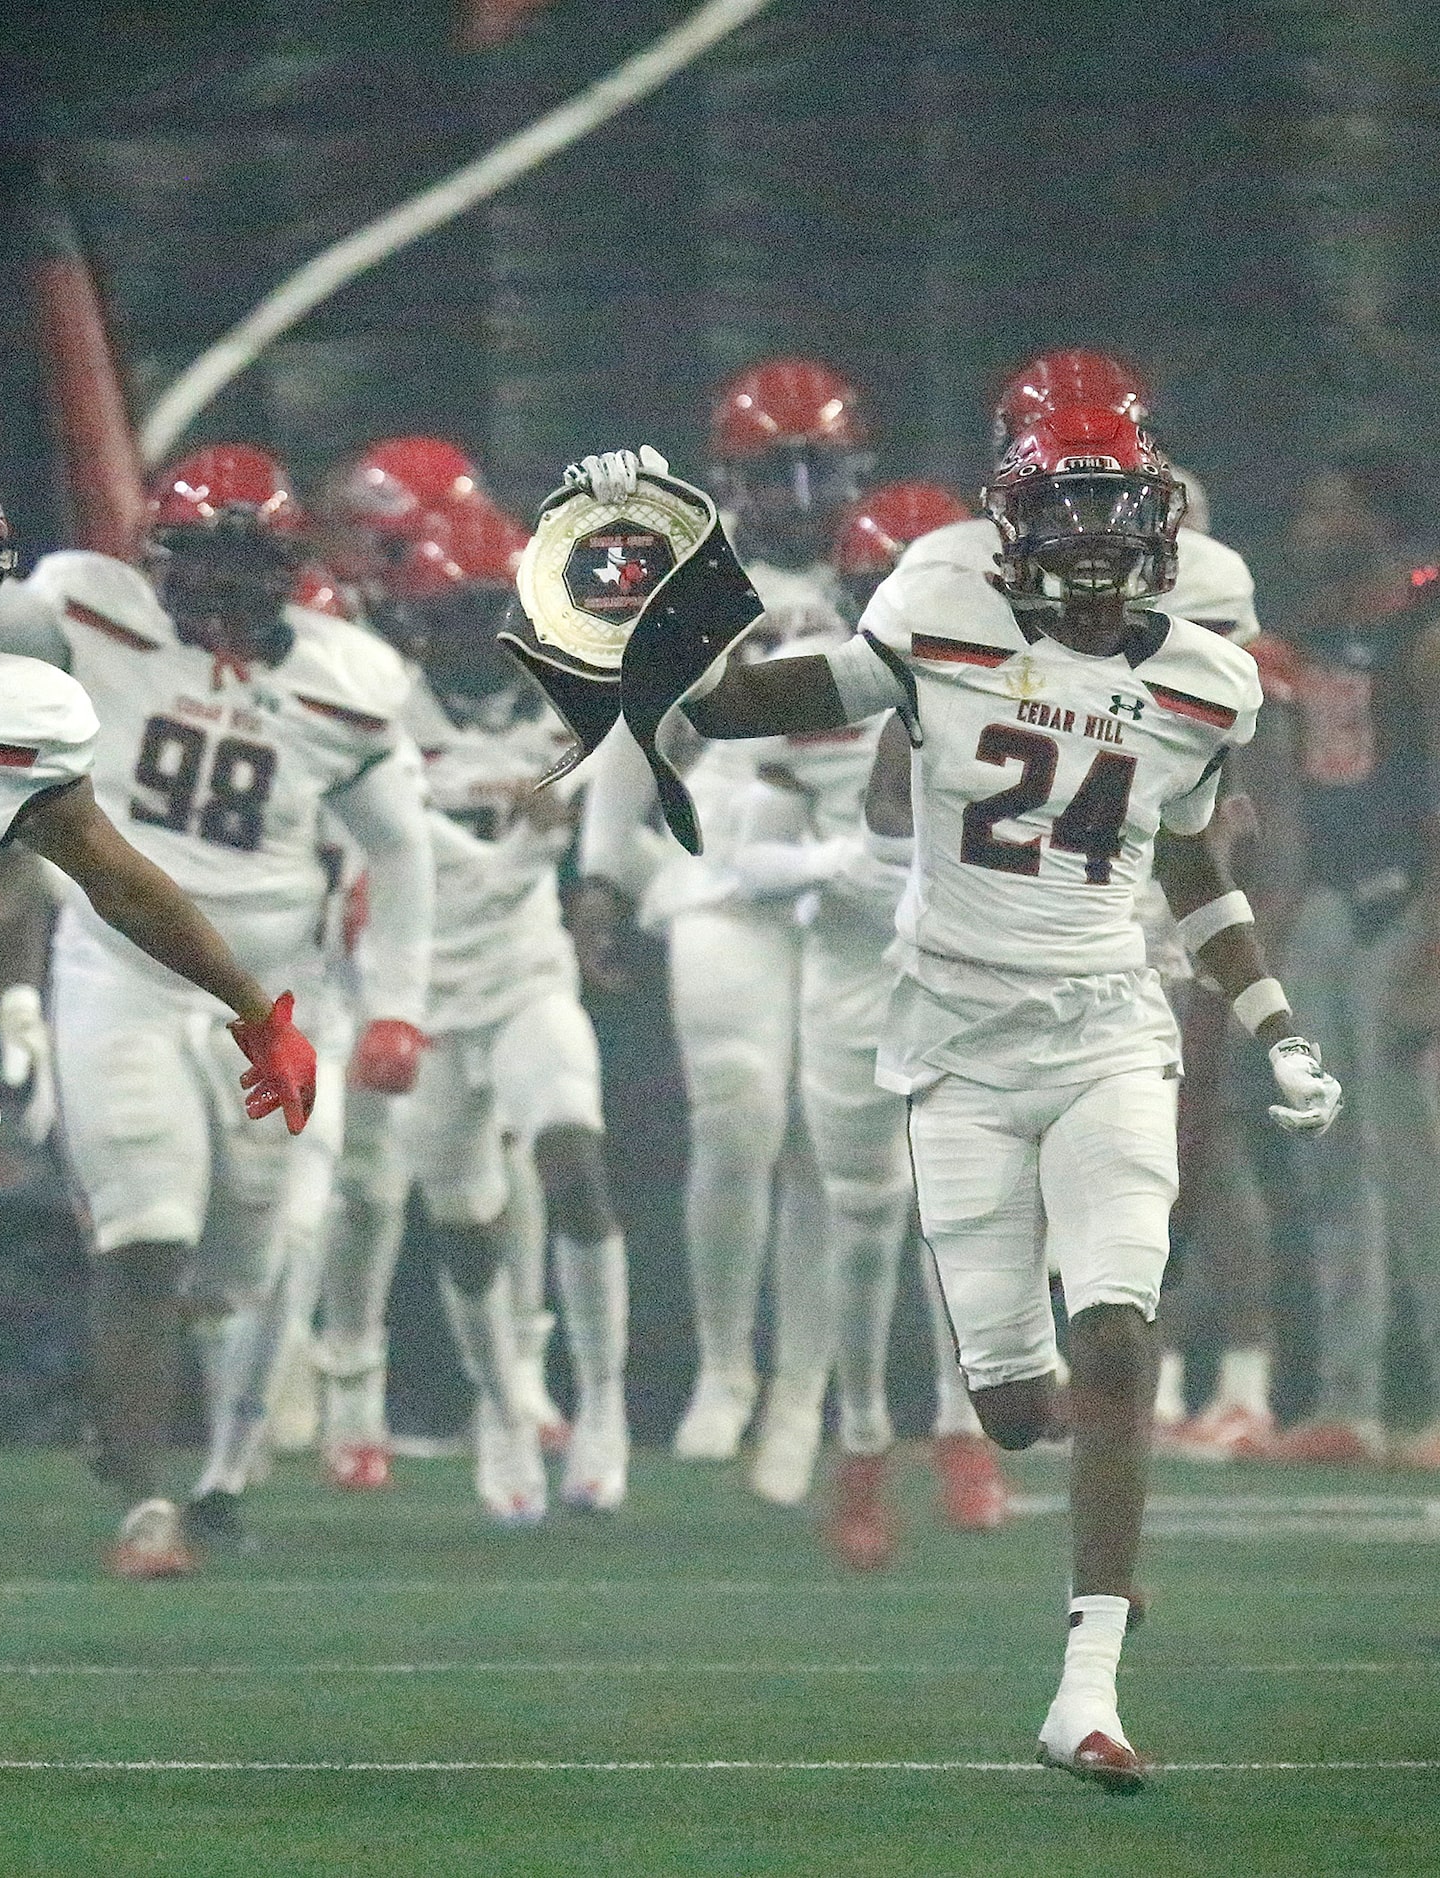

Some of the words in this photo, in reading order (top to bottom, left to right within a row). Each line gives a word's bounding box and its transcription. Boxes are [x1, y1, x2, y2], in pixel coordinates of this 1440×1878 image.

[128, 714, 278, 852] 98
[1016, 699, 1076, 733] CEDAR
[1083, 713, 1125, 745] HILL
[960, 723, 1139, 885] 24
